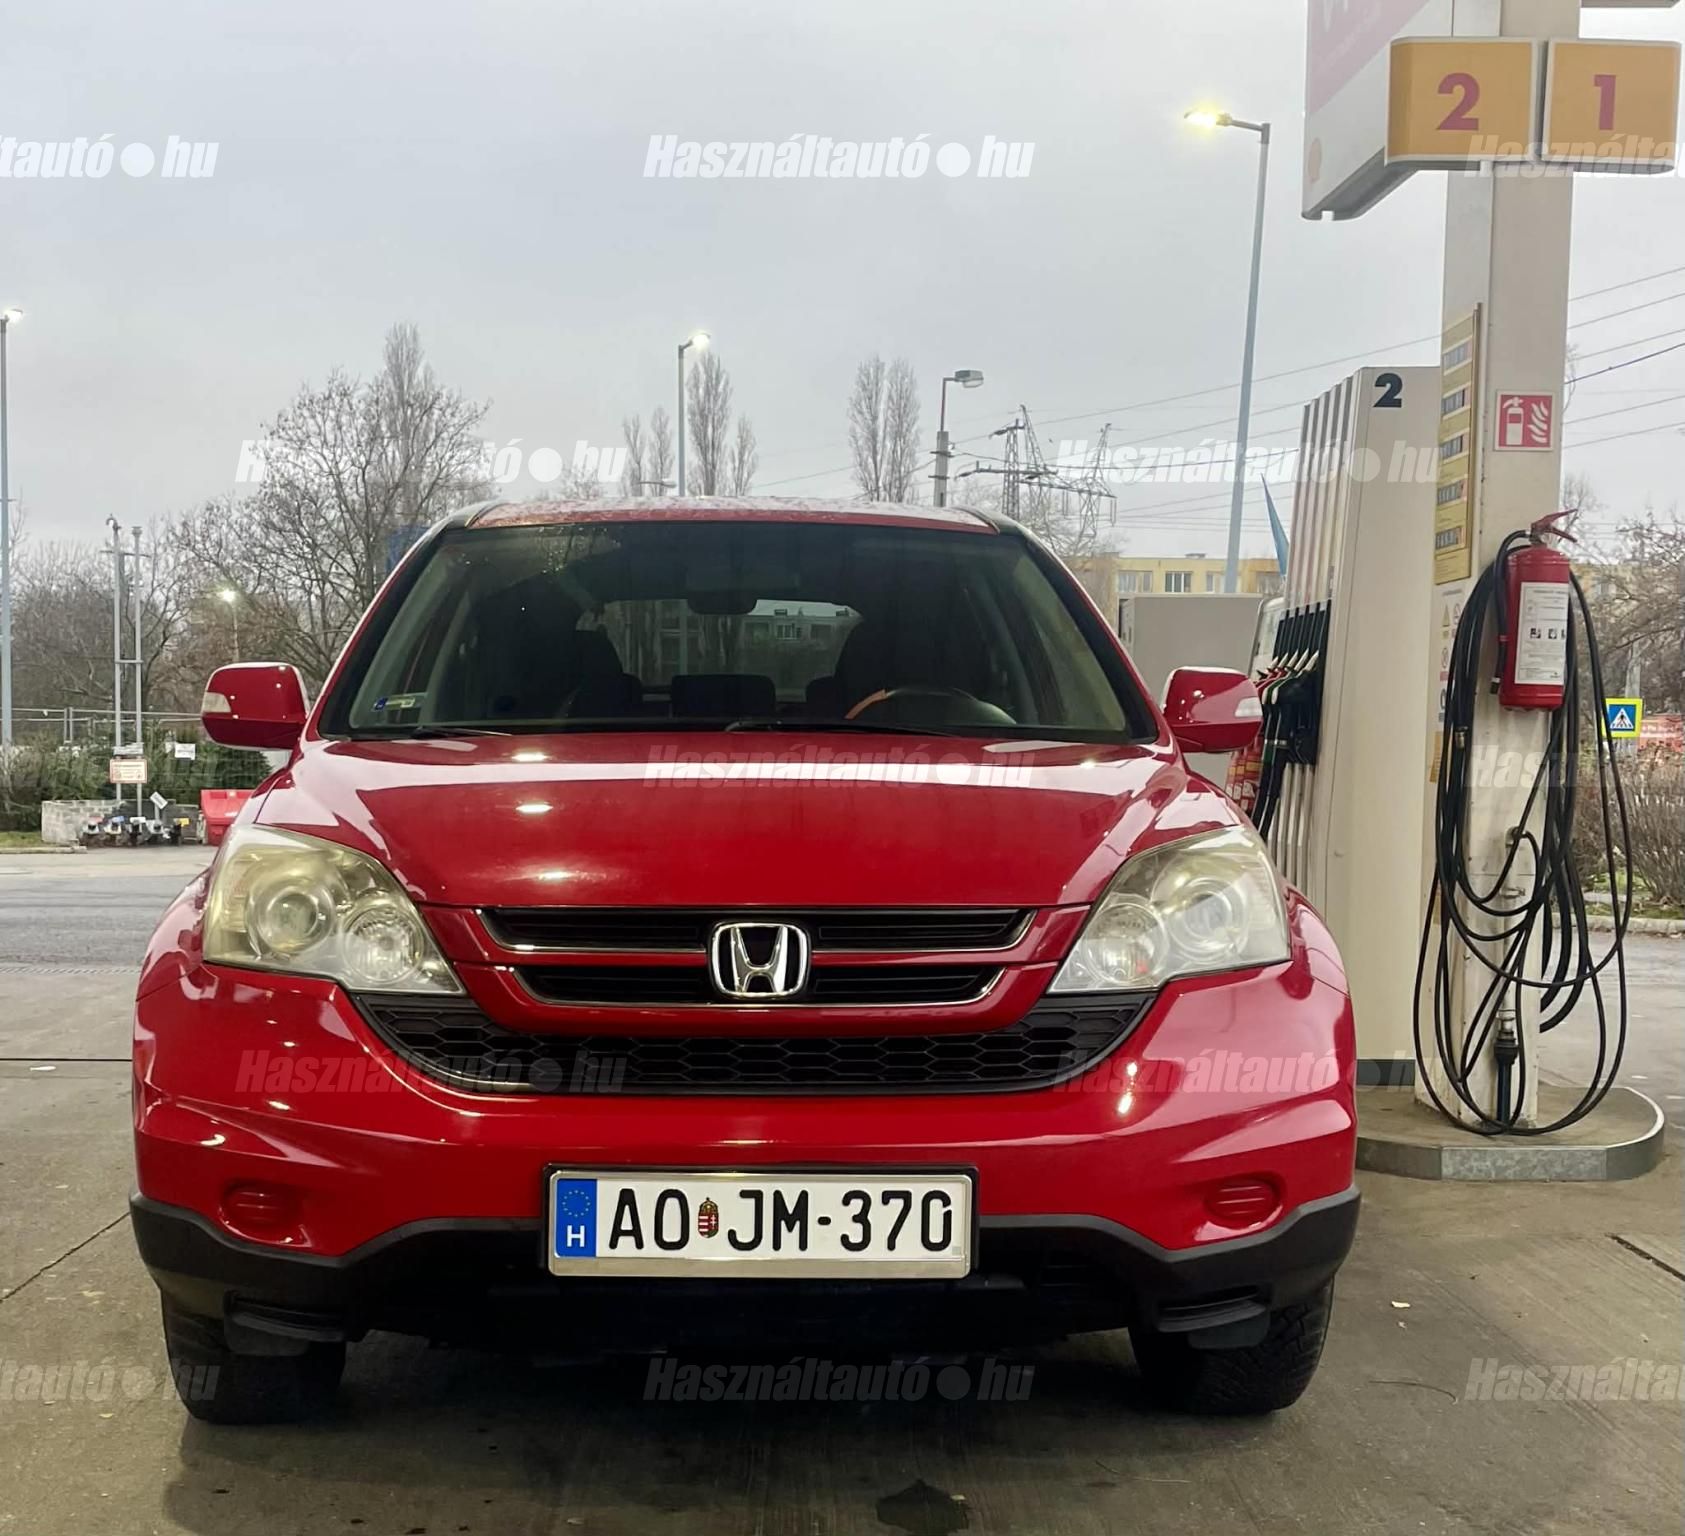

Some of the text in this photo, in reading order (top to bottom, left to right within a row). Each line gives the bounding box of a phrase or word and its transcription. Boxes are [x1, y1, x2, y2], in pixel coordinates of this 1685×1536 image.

[1436, 72, 1480, 131] 2
[1593, 74, 1617, 130] 1
[1373, 372, 1403, 408] 2
[566, 1225, 586, 1248] H
[608, 1188, 953, 1252] AO JM-370
